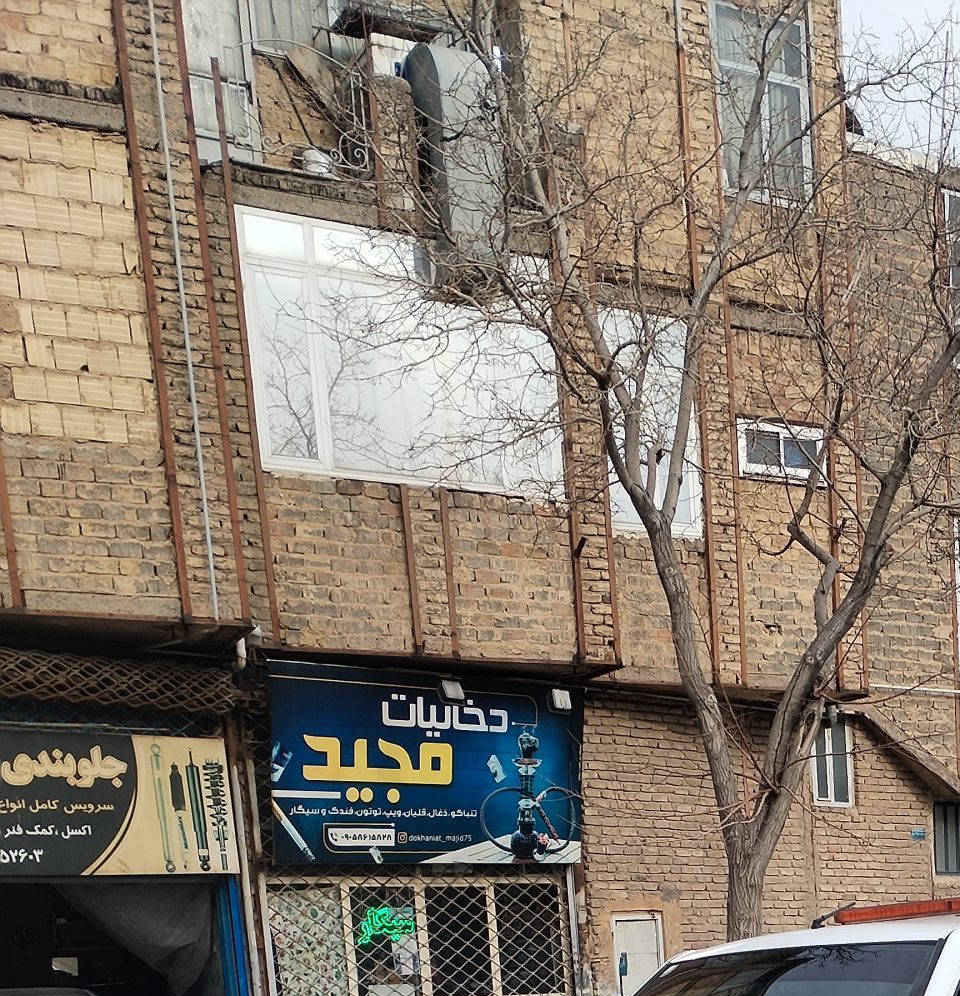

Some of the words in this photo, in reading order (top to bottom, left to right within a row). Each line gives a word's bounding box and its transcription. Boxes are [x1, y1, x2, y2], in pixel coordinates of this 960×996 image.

[382, 693, 508, 737] دخانیات
[1, 745, 128, 788] جلوبندی
[302, 733, 453, 804] مجید
[0, 799, 25, 814] انواع
[29, 799, 59, 813] کامل
[64, 803, 114, 814] سرویس
[289, 804, 320, 816] سیگار
[321, 808, 326, 816] و
[328, 806, 354, 815] فندک
[4, 823, 23, 838] فنر
[61, 825, 92, 839] اکسل
[341, 833, 392, 841] ۰۹۰۵۸۶۱۵۸۲۸
[408, 834, 472, 843] dokhaniat_majid75
